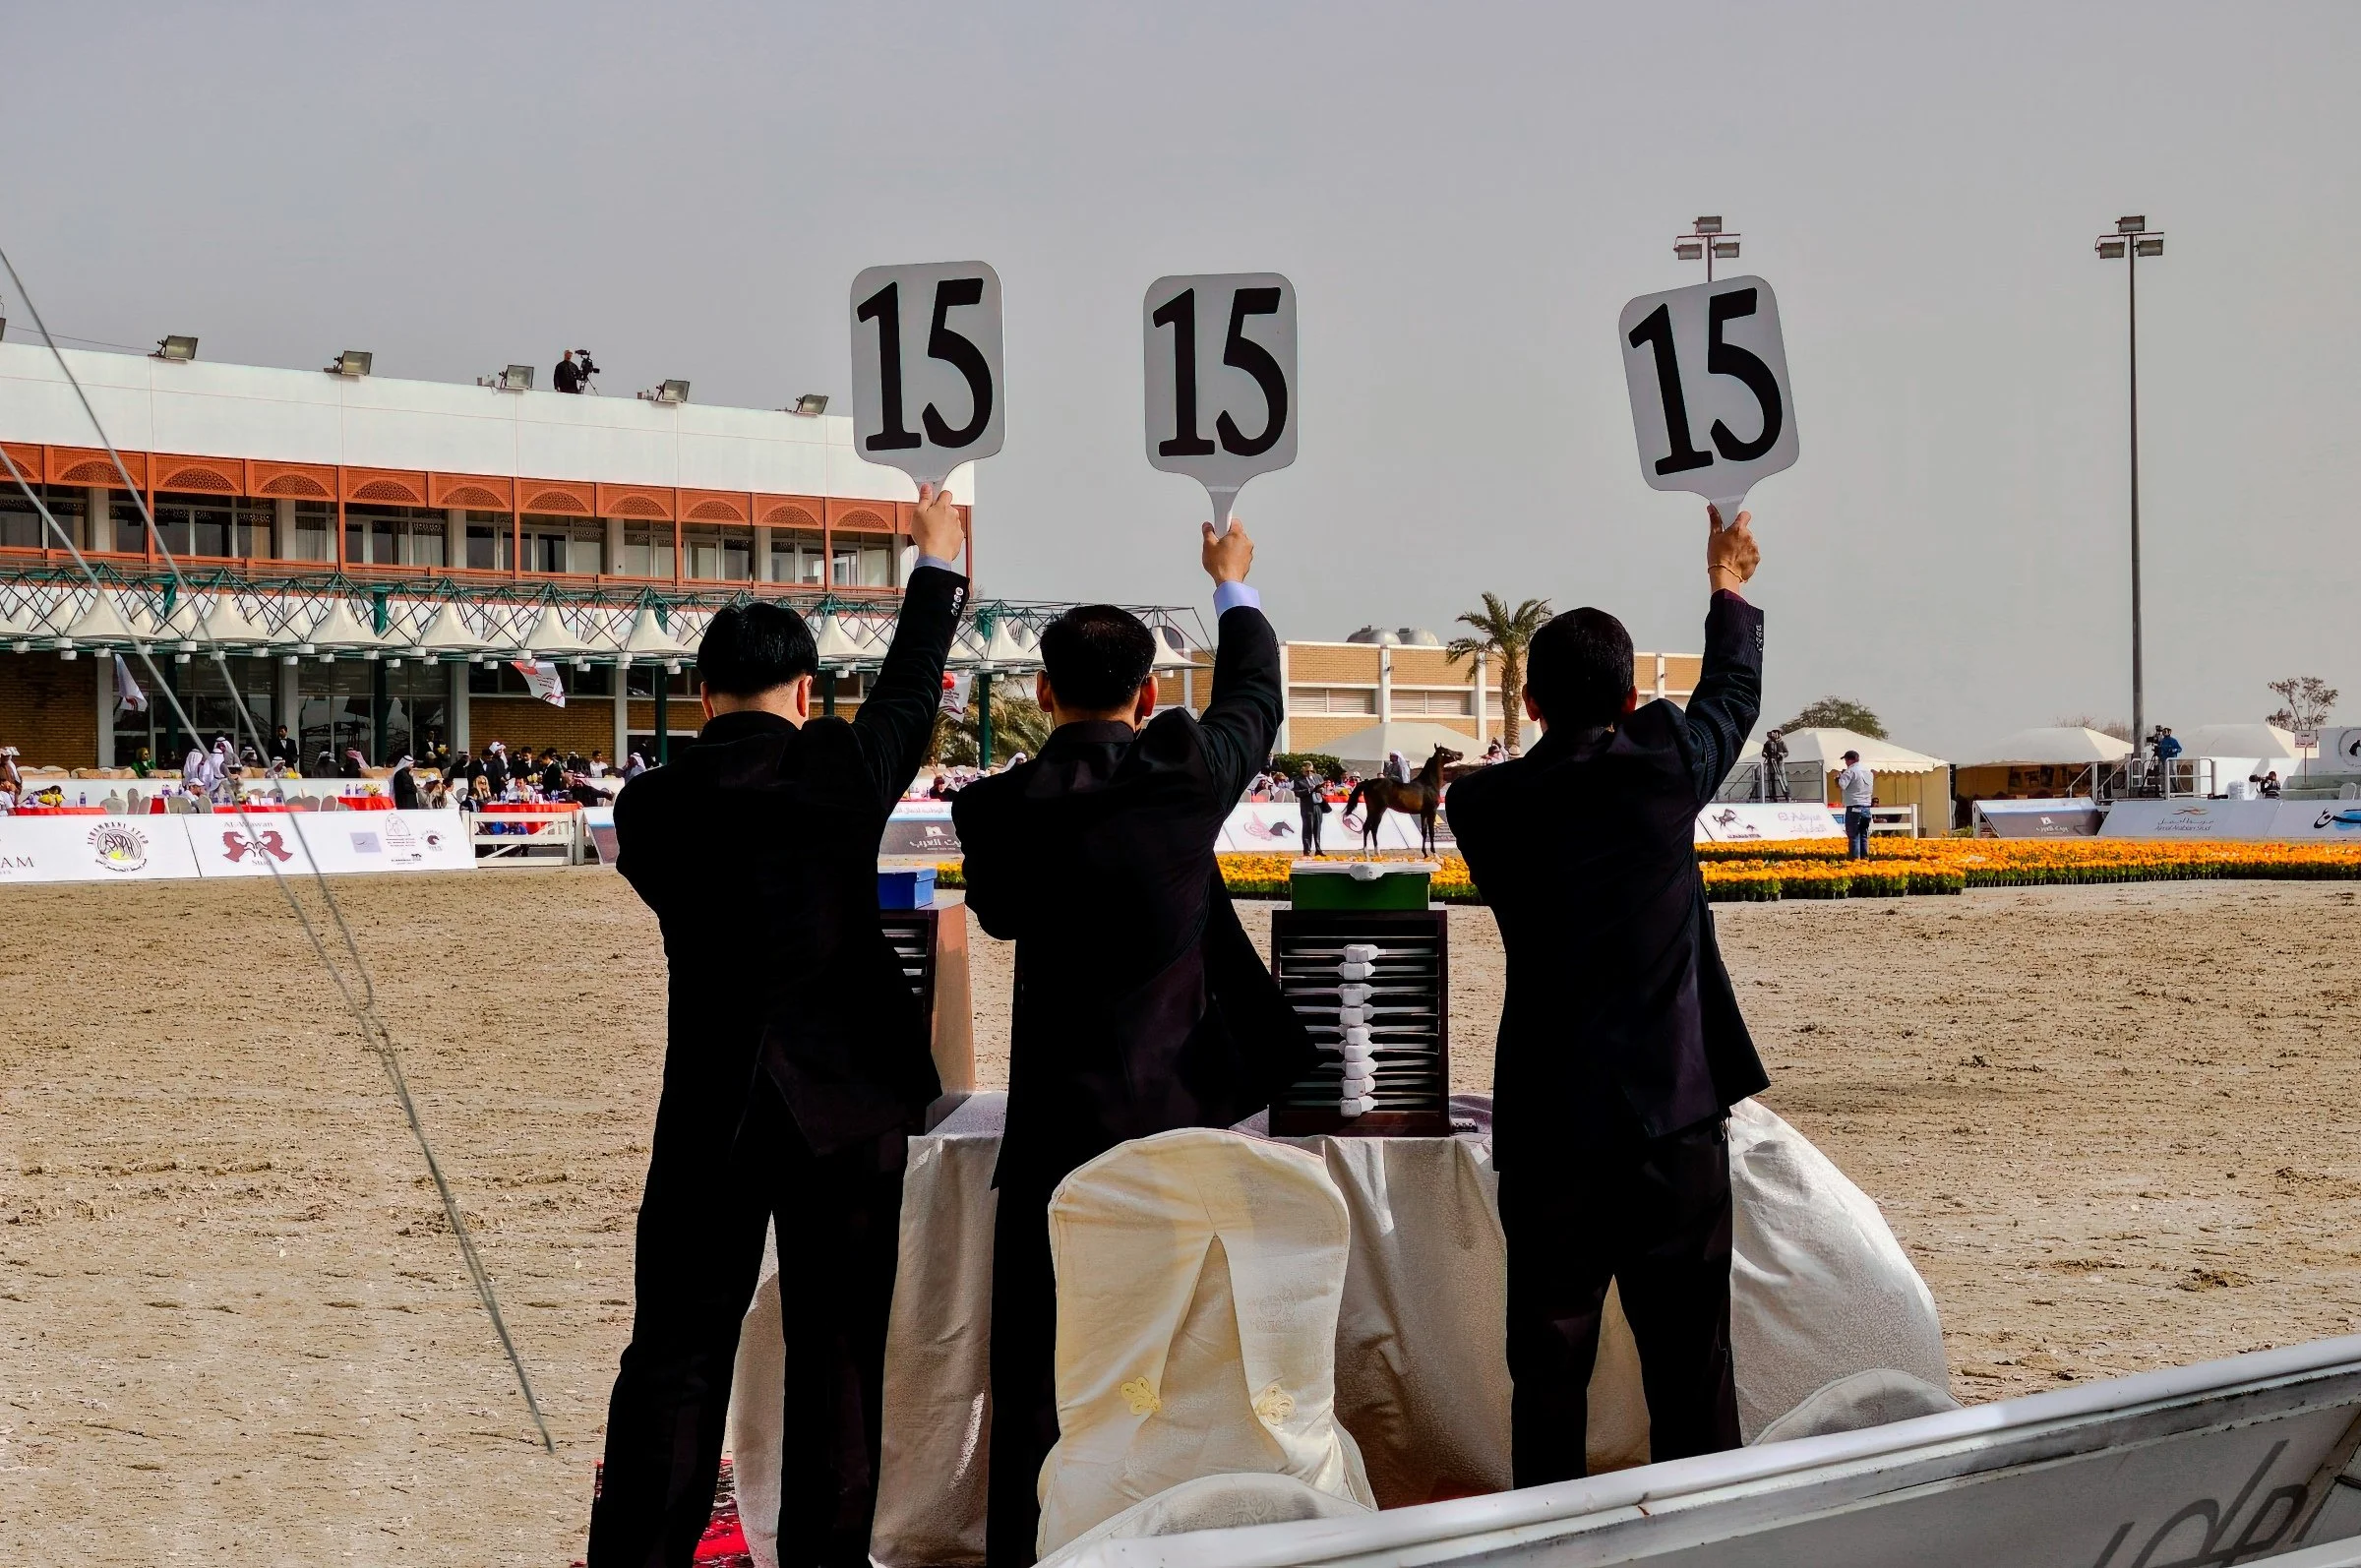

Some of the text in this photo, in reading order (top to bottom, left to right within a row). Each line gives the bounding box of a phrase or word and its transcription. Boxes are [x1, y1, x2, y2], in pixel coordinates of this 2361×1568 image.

[857, 277, 994, 452] 15
[1152, 286, 1289, 457] 15
[1628, 287, 1783, 476] 15
